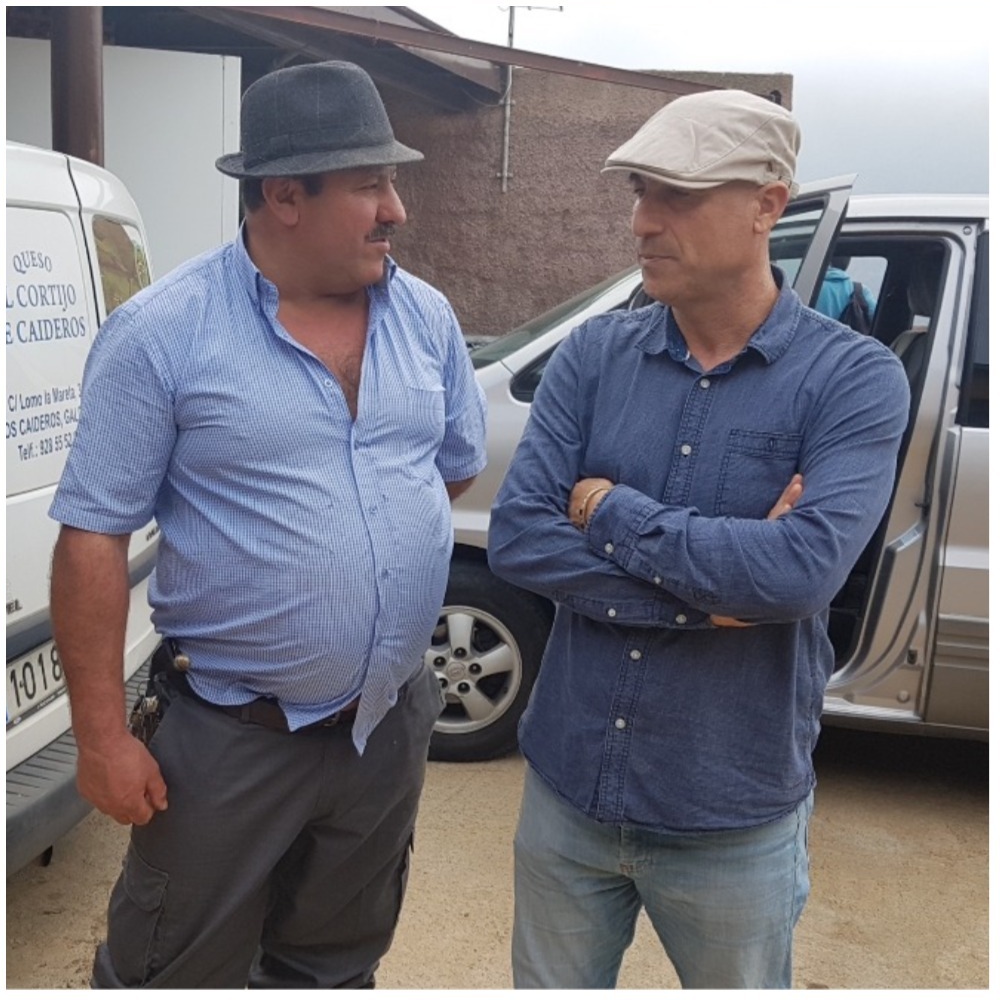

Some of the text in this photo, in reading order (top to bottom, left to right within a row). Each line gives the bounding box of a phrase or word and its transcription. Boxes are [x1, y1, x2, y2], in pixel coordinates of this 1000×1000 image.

[13, 250, 52, 274] QUESO
[6, 284, 77, 312] L CORTIJO
[6, 316, 86, 345] E CAIDEROS
[8, 394, 18, 412] C/
[6, 420, 17, 439] OS
[63, 406, 81, 424] GAL
[6, 599, 22, 615] EL
